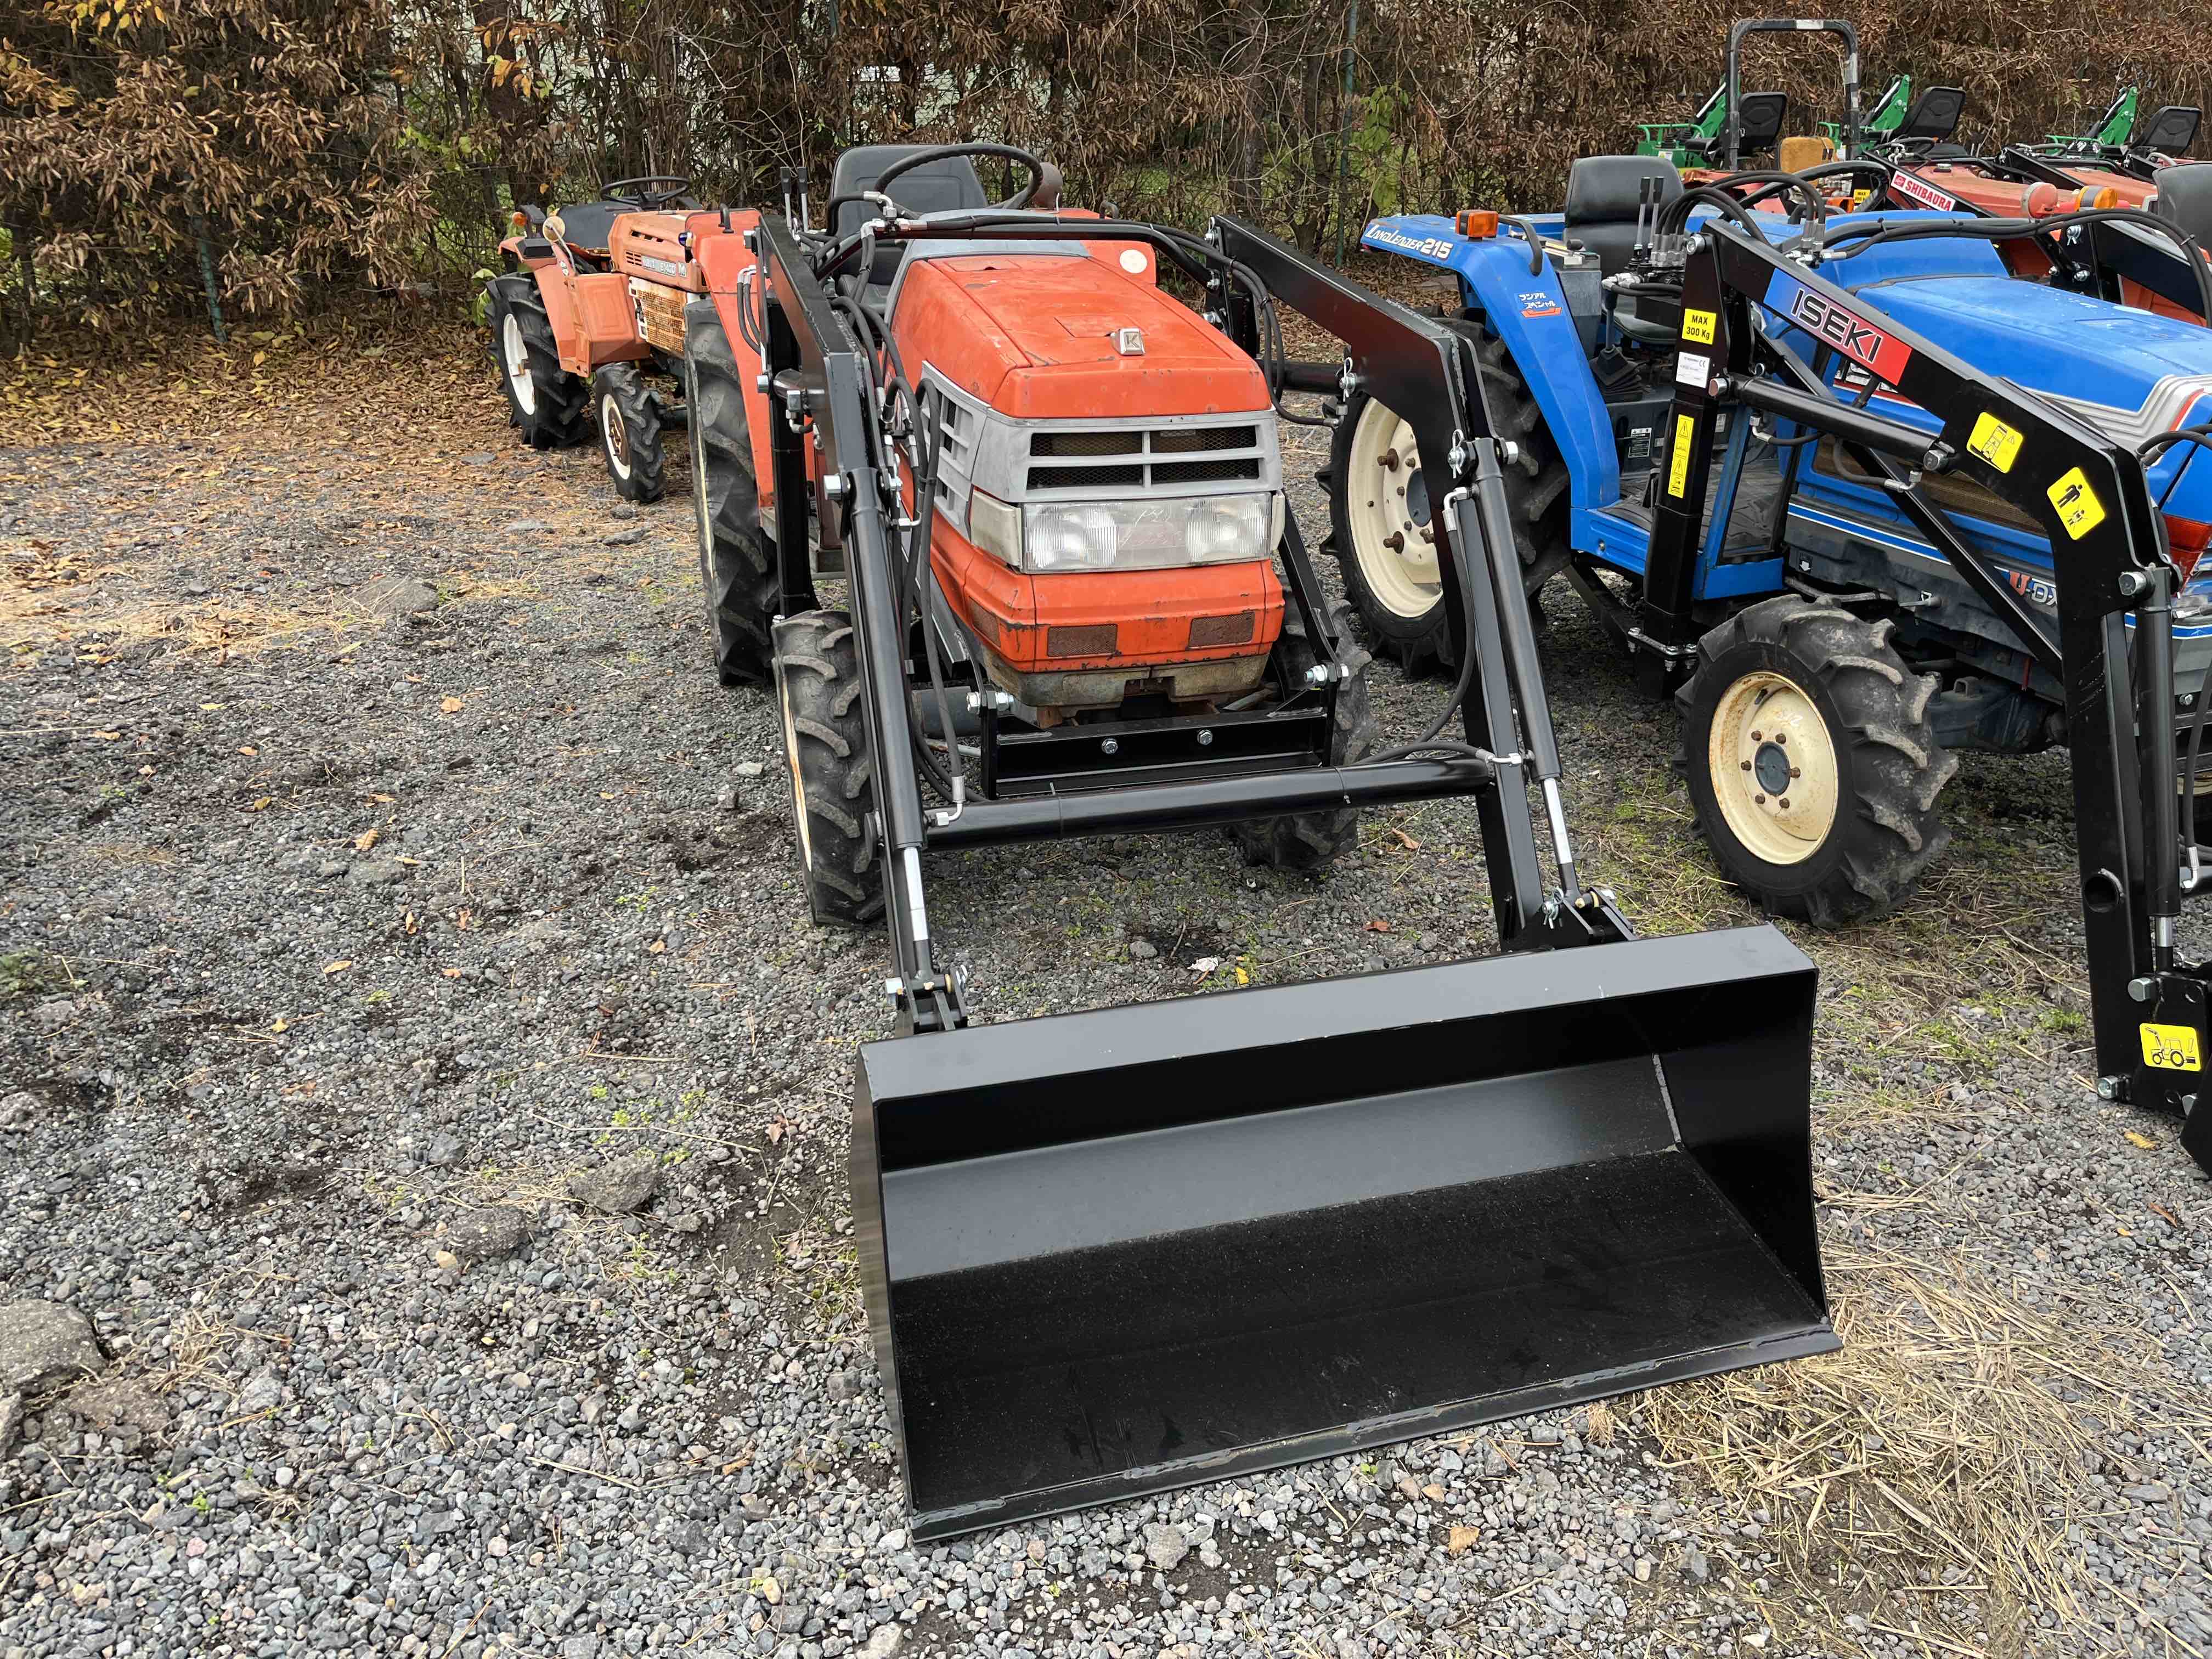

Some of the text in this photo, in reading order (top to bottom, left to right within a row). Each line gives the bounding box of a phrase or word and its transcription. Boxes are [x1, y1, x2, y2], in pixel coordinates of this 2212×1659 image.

[1905, 180, 1952, 211] SHIBAURA
[1420, 238, 1454, 260] 215
[1691, 314, 1708, 325] MAX
[1791, 287, 1883, 364] ISEKI
[1686, 326, 1710, 341] 300 Kg
